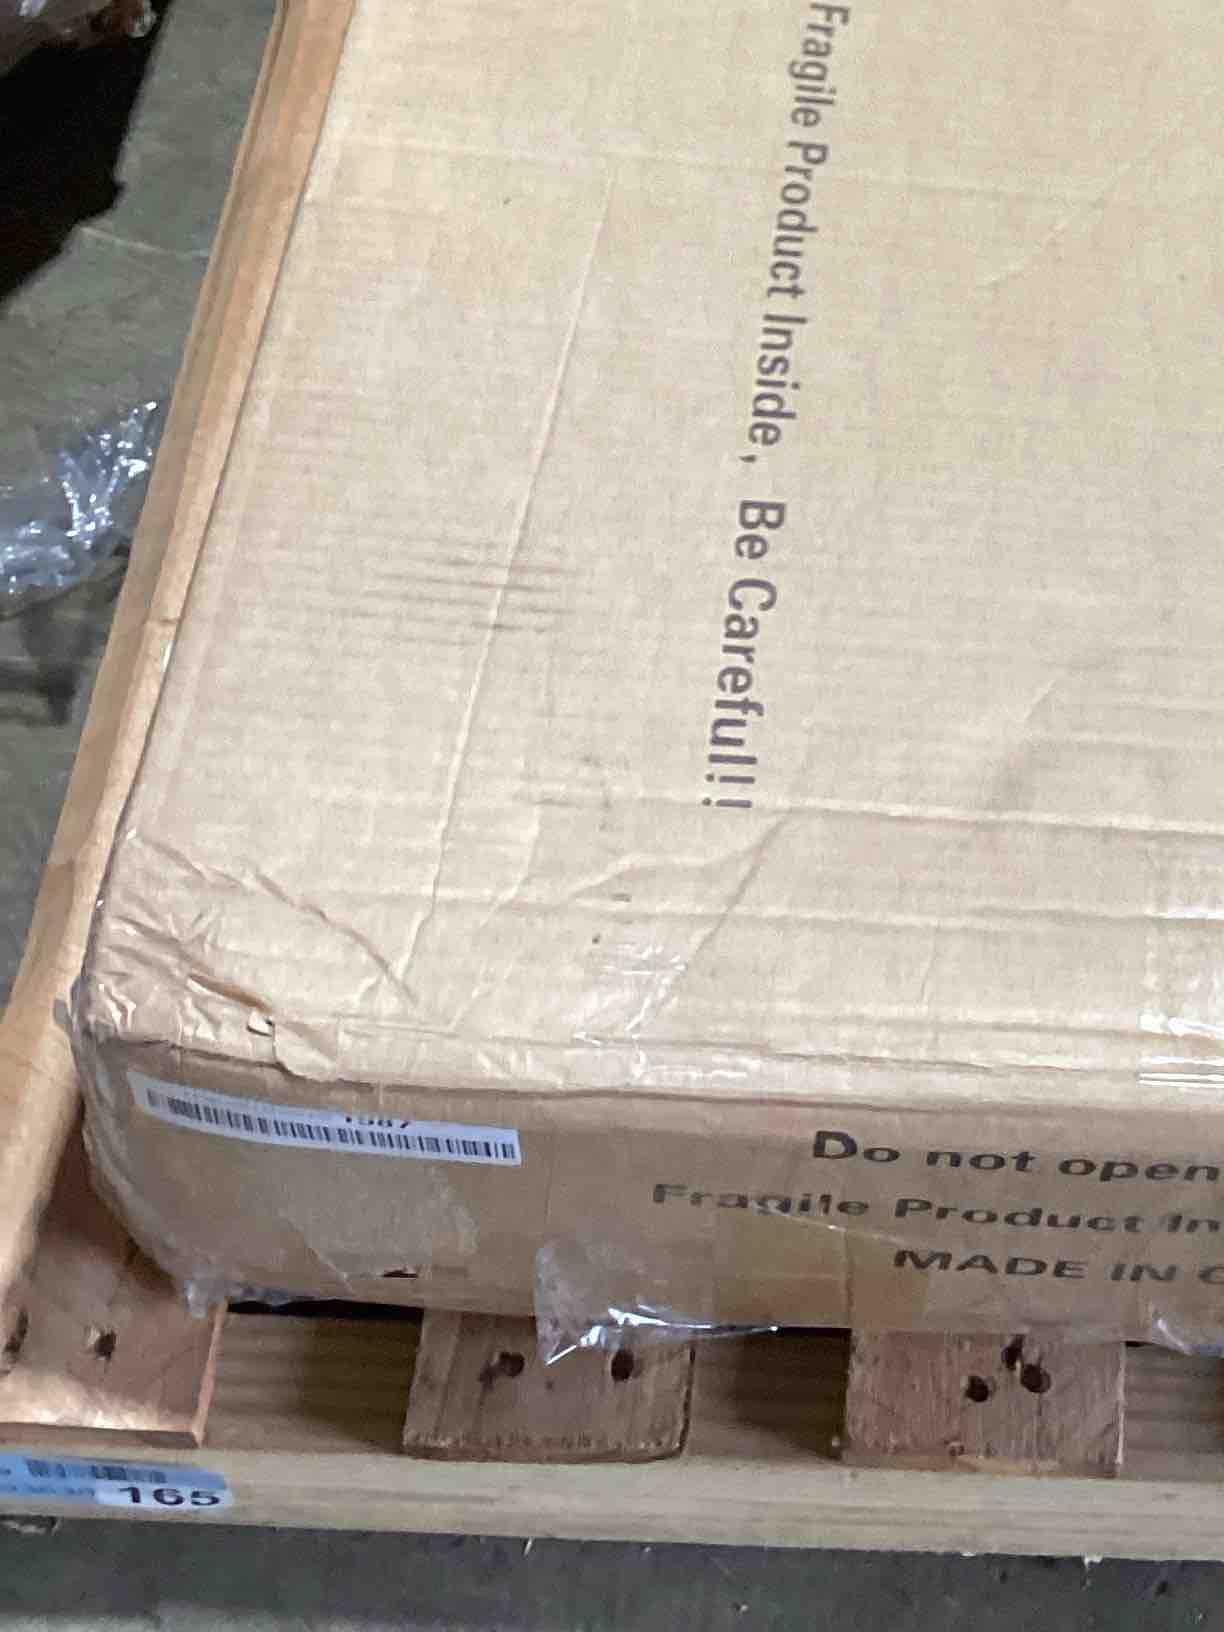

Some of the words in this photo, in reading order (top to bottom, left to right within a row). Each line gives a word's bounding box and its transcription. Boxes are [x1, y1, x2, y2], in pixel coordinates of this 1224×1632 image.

[788, 1, 851, 129] Fragile
[766, 141, 829, 299] Product
[738, 312, 808, 466] Inside,
[734, 499, 787, 562] Be
[701, 576, 778, 811] Careful!!
[811, 1129, 900, 1164] Do
[925, 1148, 1038, 1175] not
[1057, 1156, 1220, 1183] open
[651, 1182, 870, 1219] Fragile
[893, 1197, 1144, 1234] Product
[893, 1248, 1087, 1279] MADE
[1111, 1263, 1178, 1283] IN
[119, 1486, 220, 1506] 165
